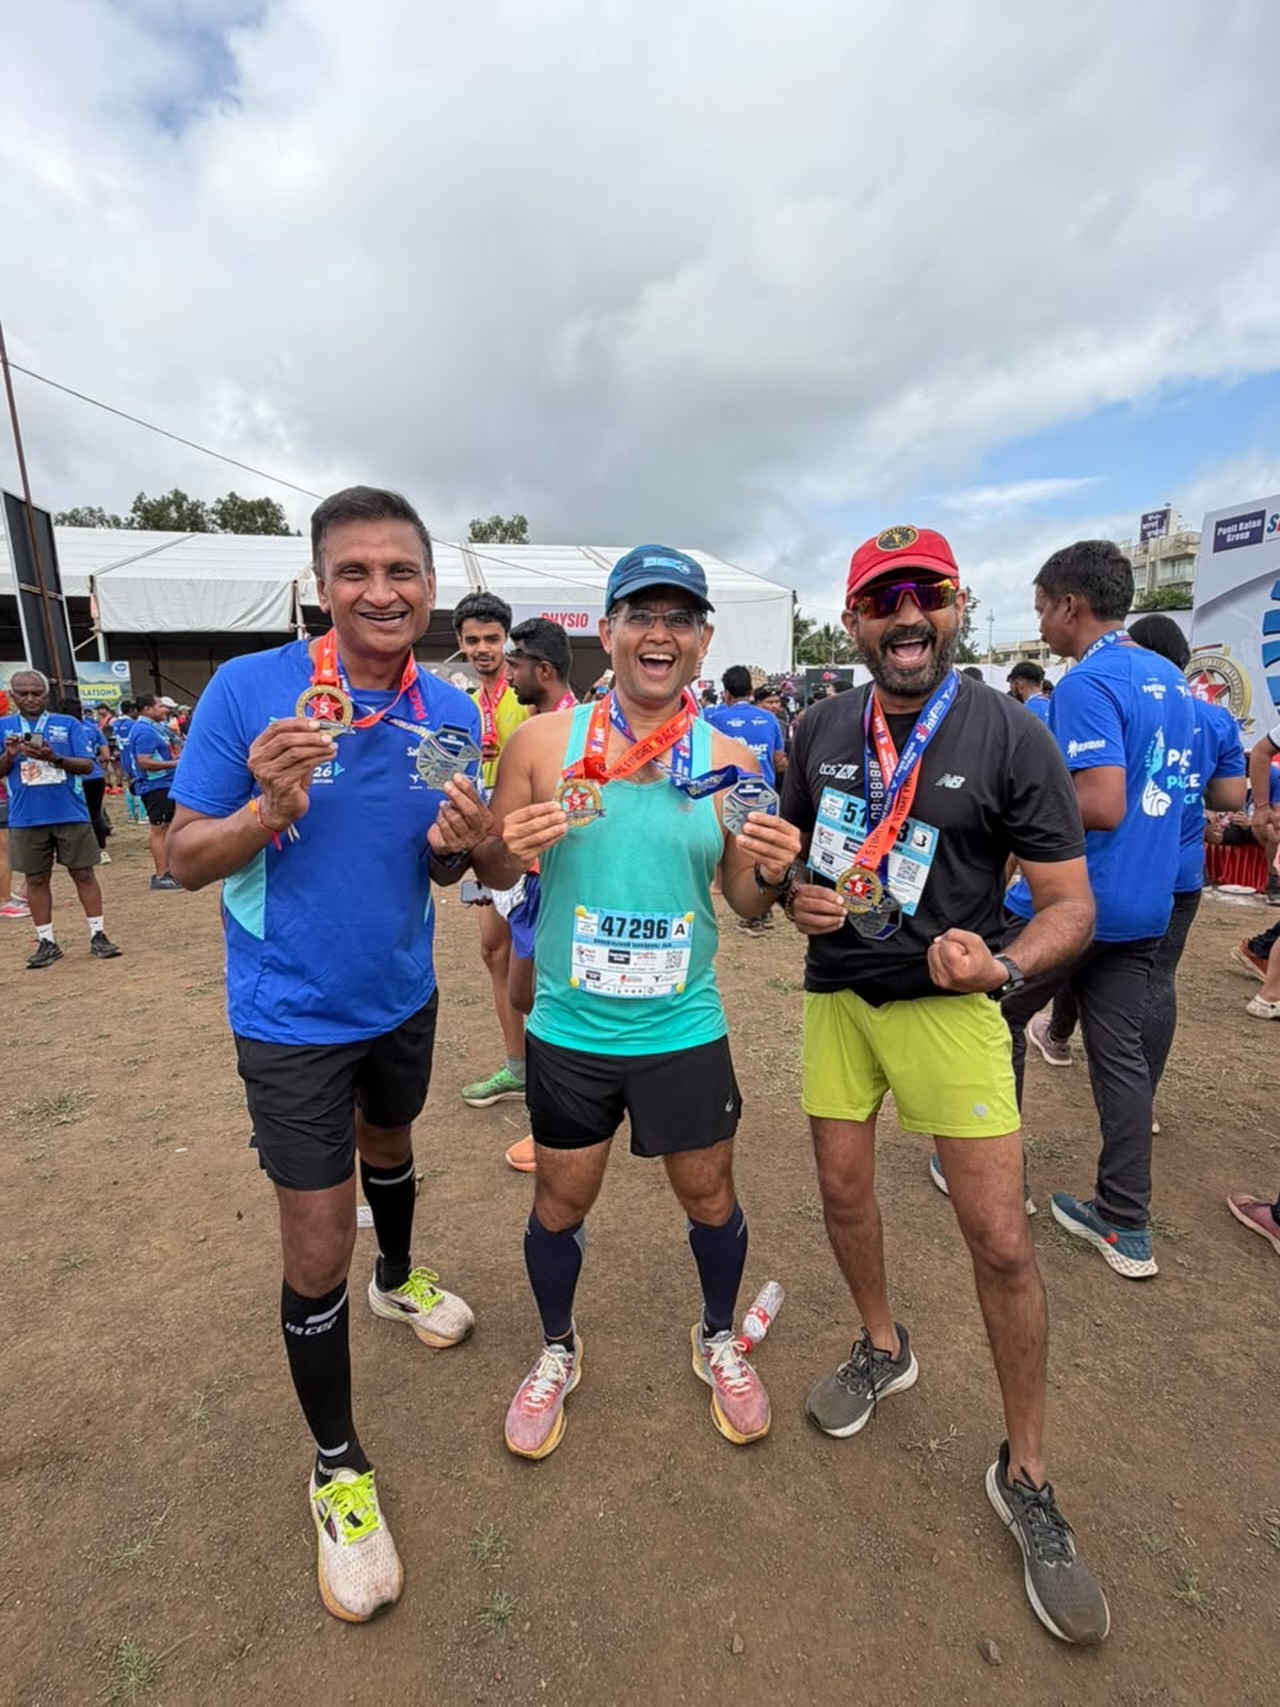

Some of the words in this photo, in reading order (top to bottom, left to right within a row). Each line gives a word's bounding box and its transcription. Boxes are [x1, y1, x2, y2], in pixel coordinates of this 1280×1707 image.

[1217, 524, 1238, 536] Punit
[1226, 530, 1251, 543] Group
[1195, 683, 1209, 700] 5
[319, 702, 329, 714] 5
[656, 723, 681, 746] PACE
[573, 794, 580, 805] 5
[855, 882, 863, 893] 5
[601, 916, 668, 939] 47296
[674, 923, 685, 936] A
